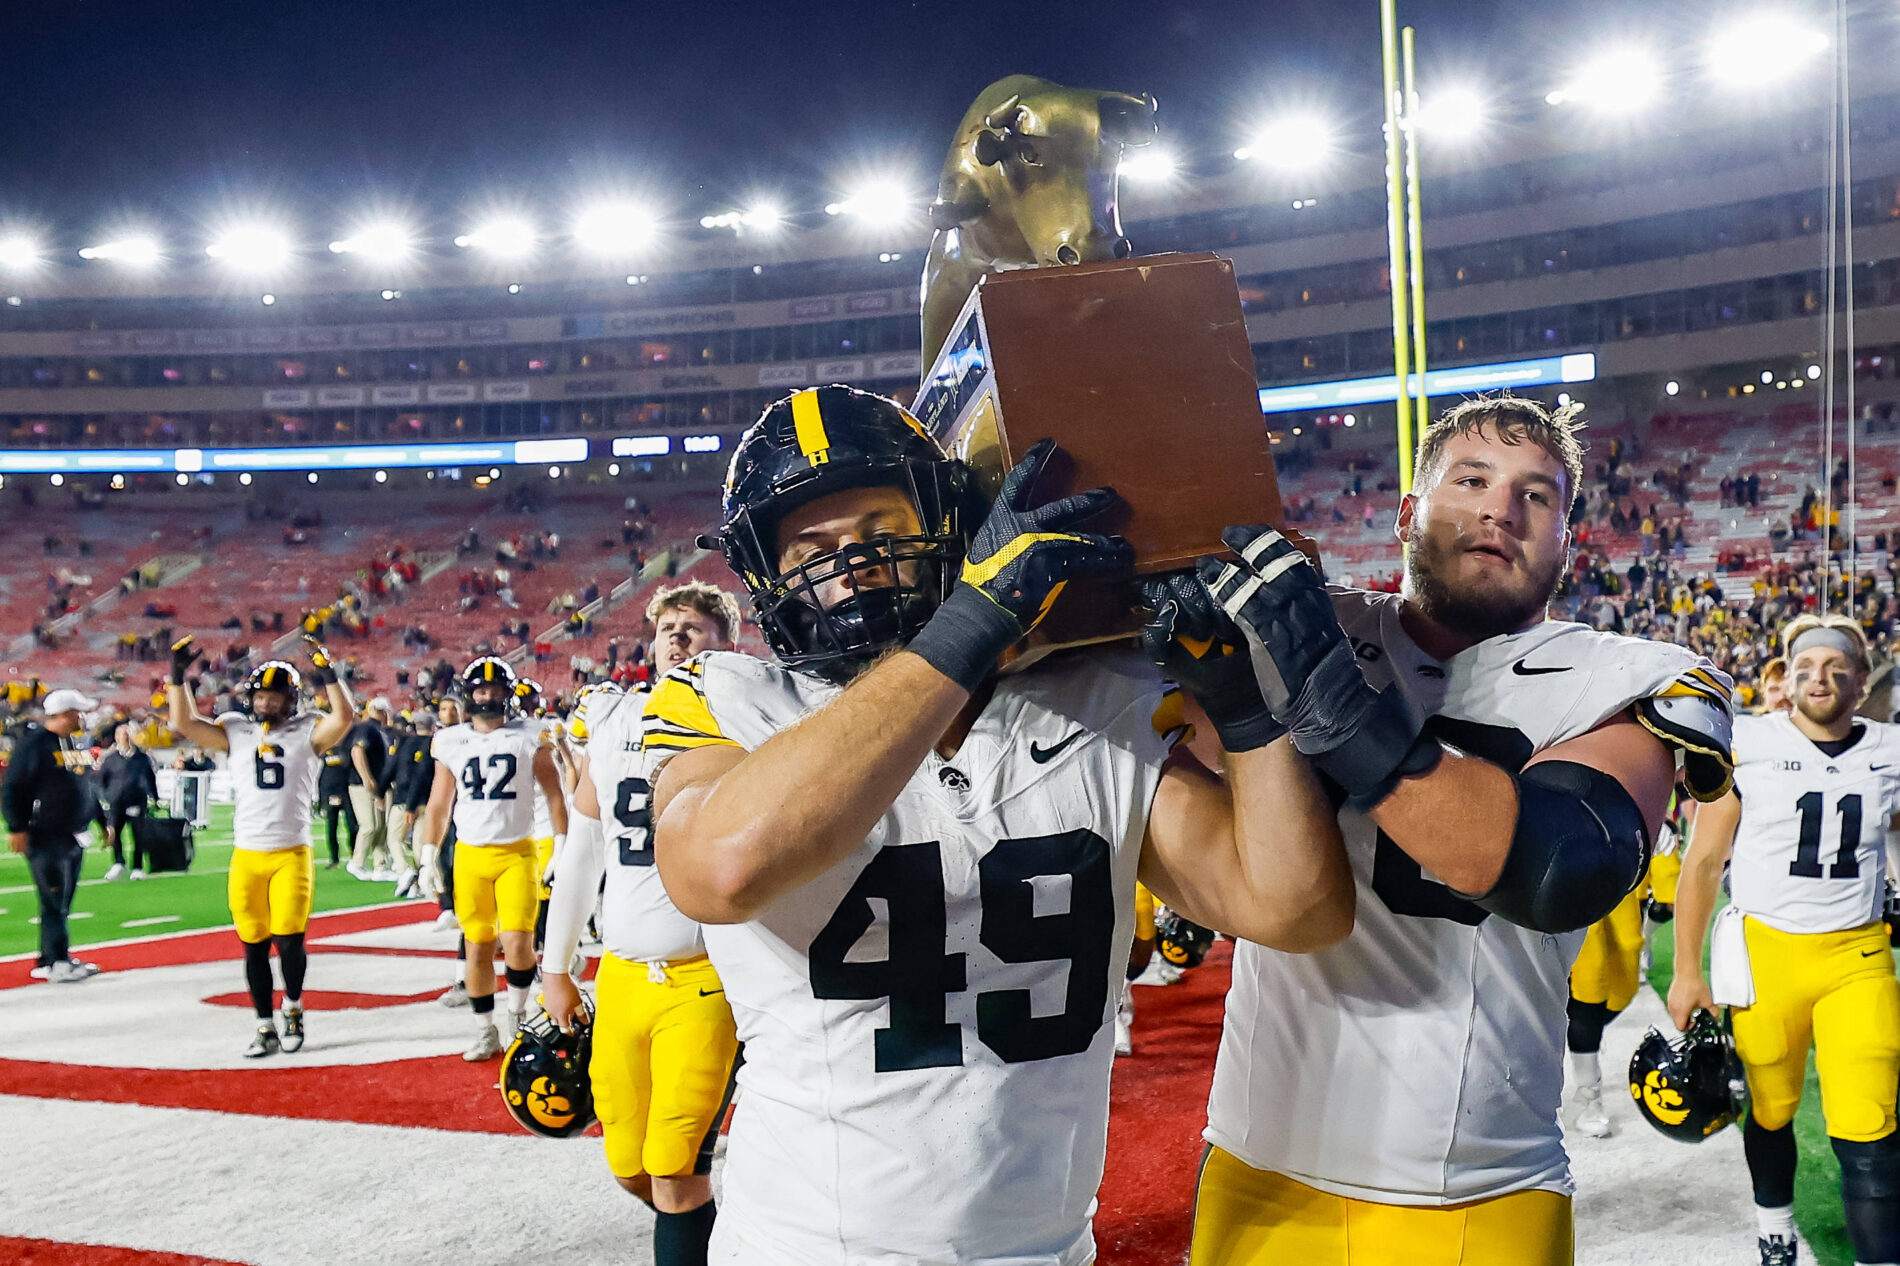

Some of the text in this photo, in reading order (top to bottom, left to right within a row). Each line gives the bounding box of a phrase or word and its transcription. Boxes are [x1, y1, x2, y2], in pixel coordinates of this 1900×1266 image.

[256, 744, 284, 789] 6
[462, 753, 516, 800] 42
[1788, 791, 1862, 879] 11
[808, 827, 1115, 1073] 49
